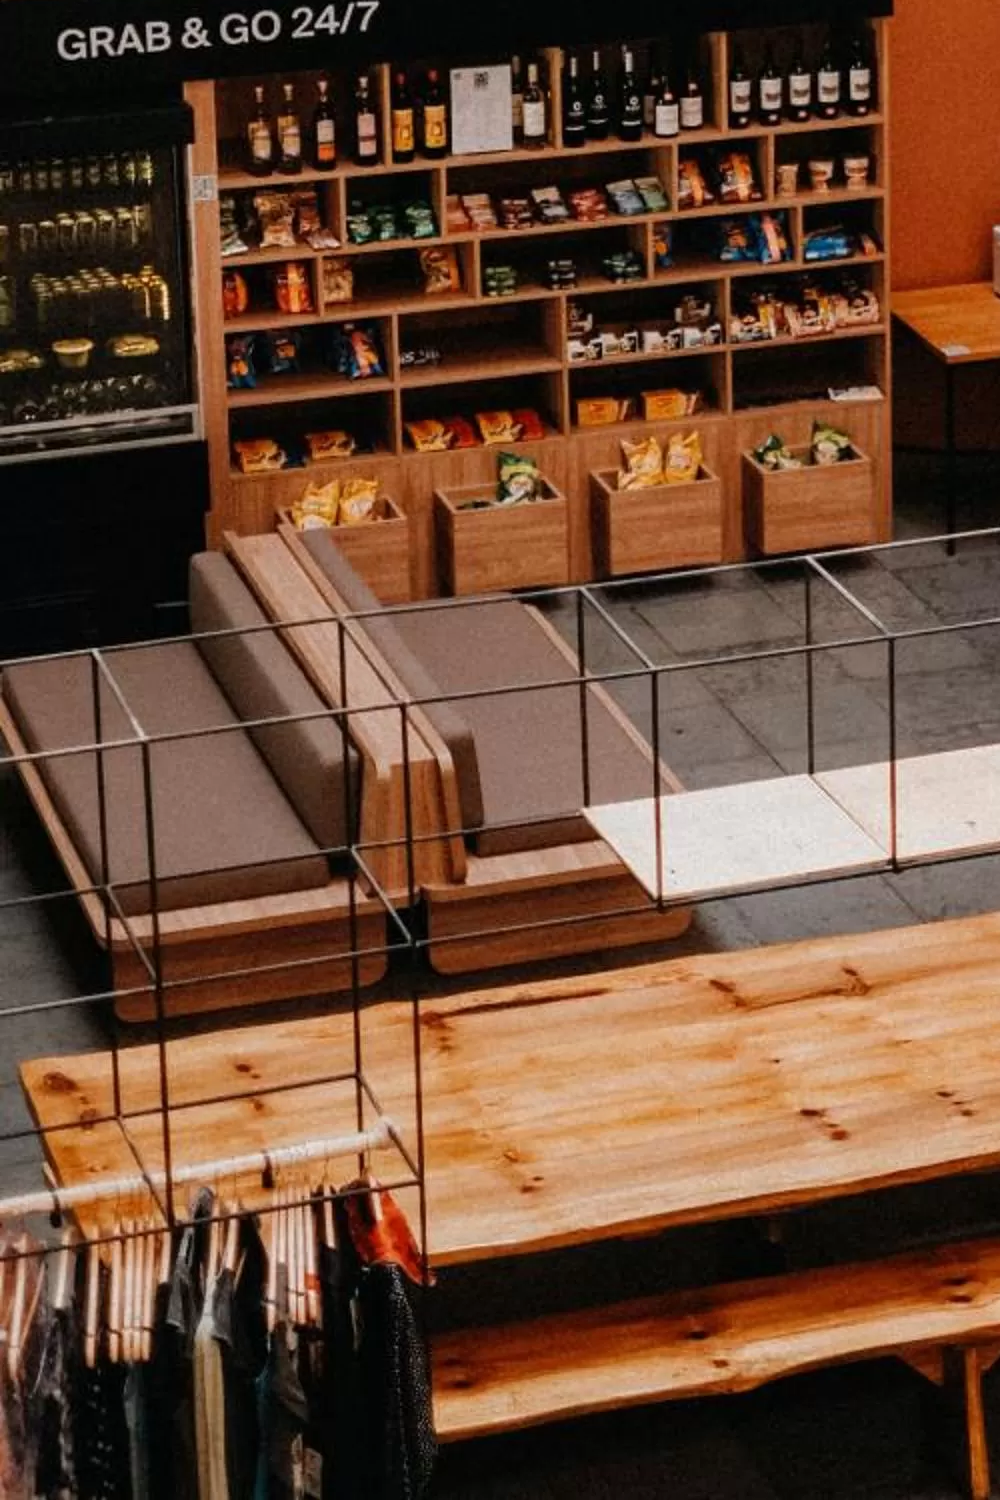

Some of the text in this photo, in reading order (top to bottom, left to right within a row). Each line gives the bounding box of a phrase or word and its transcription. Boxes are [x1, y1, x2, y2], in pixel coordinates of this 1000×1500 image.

[57, 1, 380, 60] GRAB & GO 24/7
